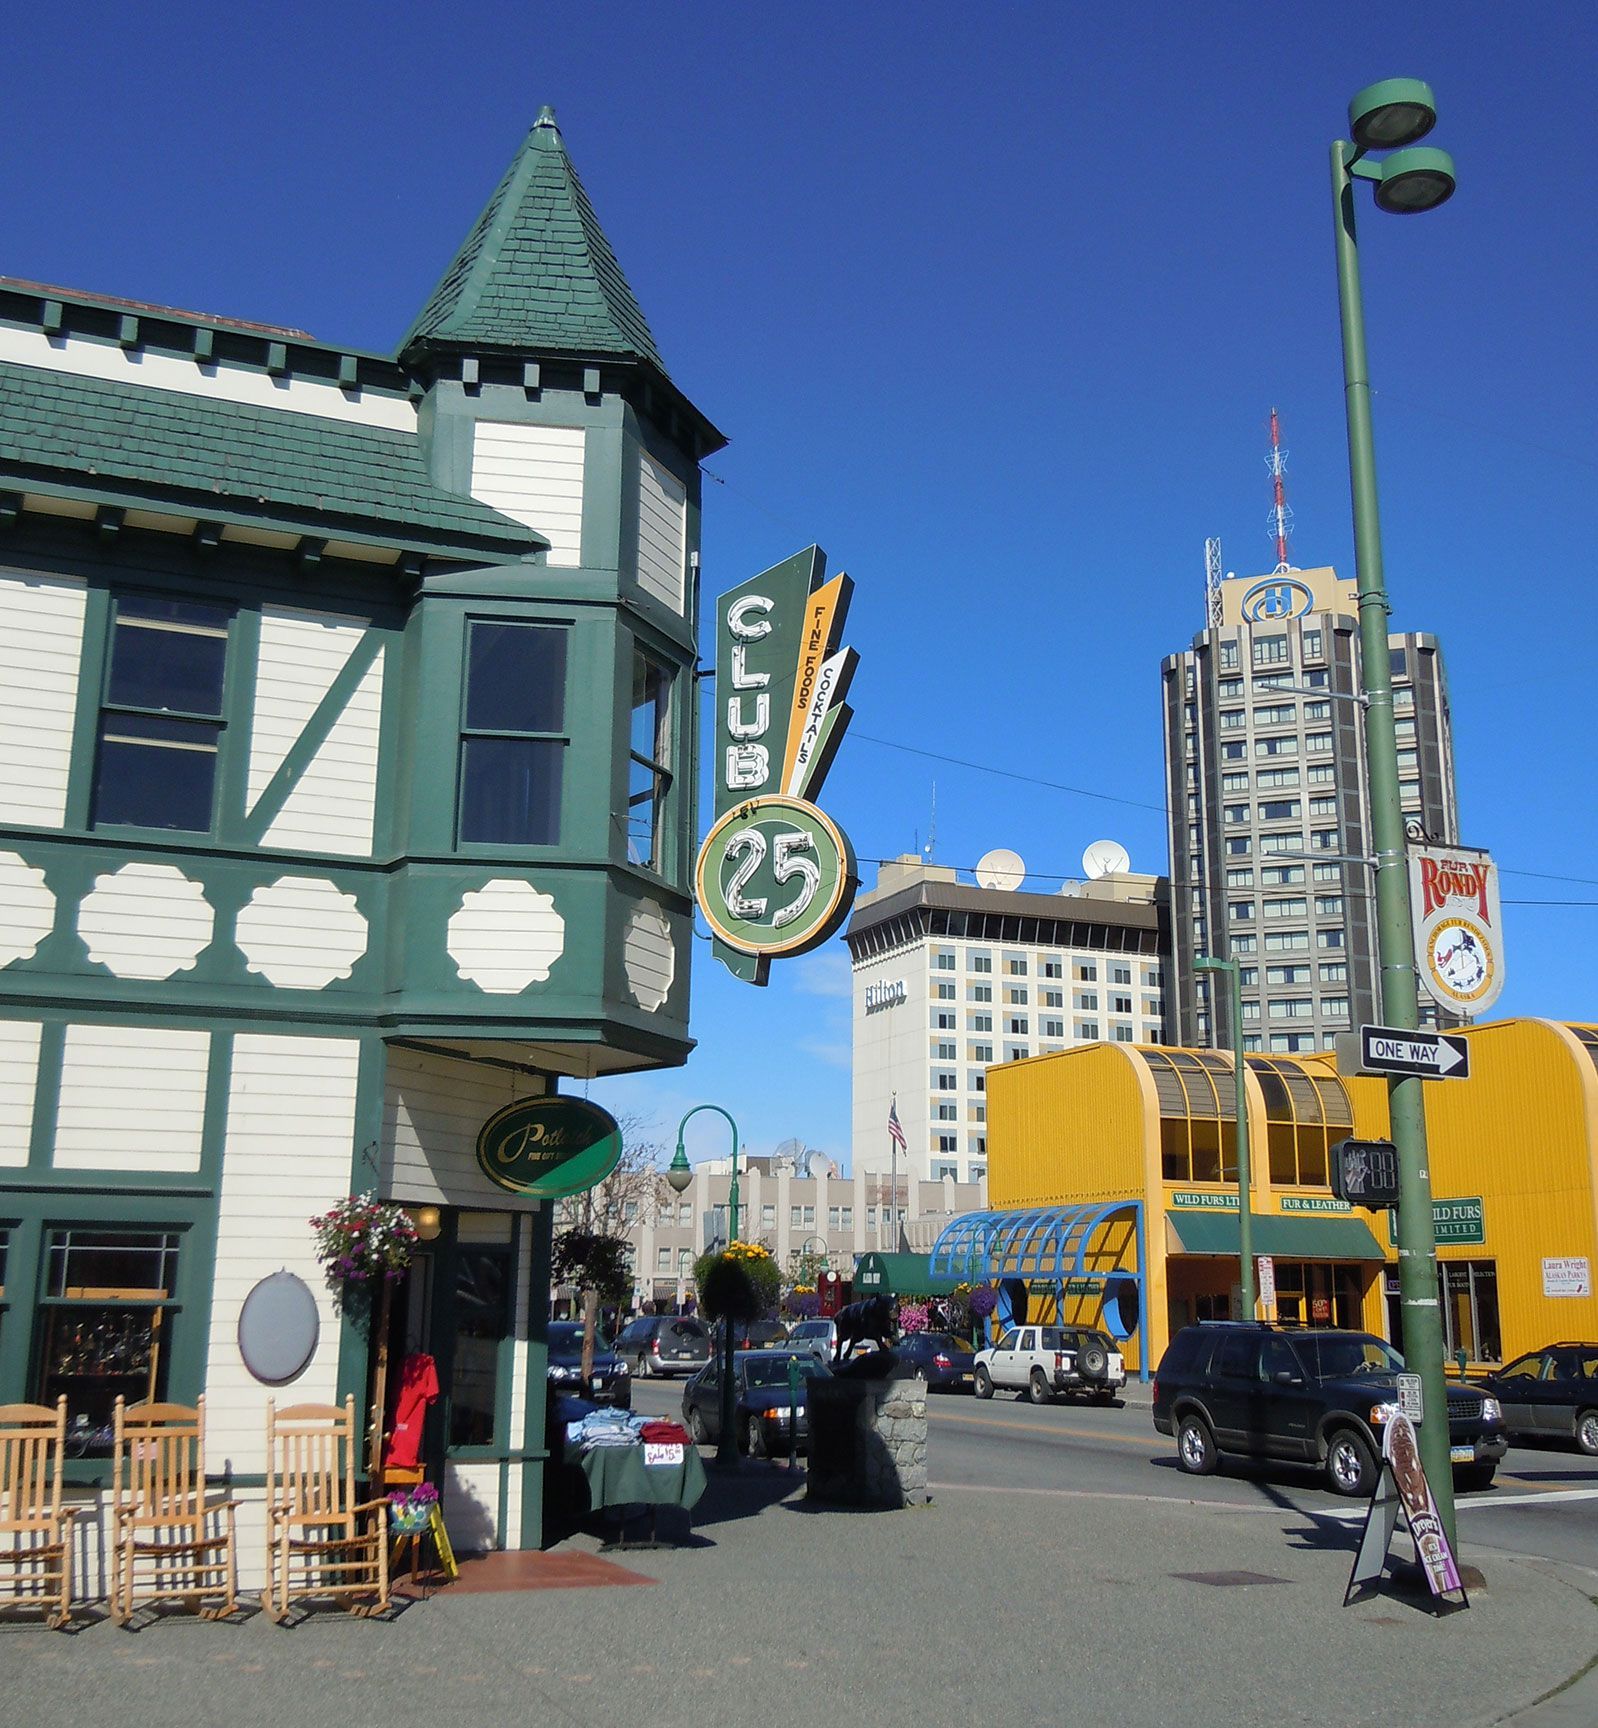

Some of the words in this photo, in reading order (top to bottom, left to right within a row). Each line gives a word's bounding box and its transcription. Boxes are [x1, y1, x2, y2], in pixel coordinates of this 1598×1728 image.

[809, 606, 826, 651] FINE
[726, 594, 775, 793] CLUB
[797, 656, 816, 709] FOODS
[798, 667, 834, 764] COCKTAILS
[725, 828, 820, 929] 25
[1440, 859, 1469, 873] FUR
[1418, 856, 1492, 929] RONDY
[865, 979, 905, 1008] Hilton
[1375, 1040, 1405, 1059] ONE
[1409, 1043, 1438, 1062] WAY
[1174, 1194, 1201, 1205] WILD
[1201, 1195, 1225, 1206] FURS
[1225, 1196, 1240, 1207] LT
[1282, 1199, 1300, 1209] FUR
[1301, 1200, 1310, 1209] &
[1311, 1200, 1351, 1211] LEATHER
[1432, 1206, 1452, 1221] ILD
[1453, 1205, 1482, 1220] FURS
[1435, 1224, 1477, 1234] IMITED
